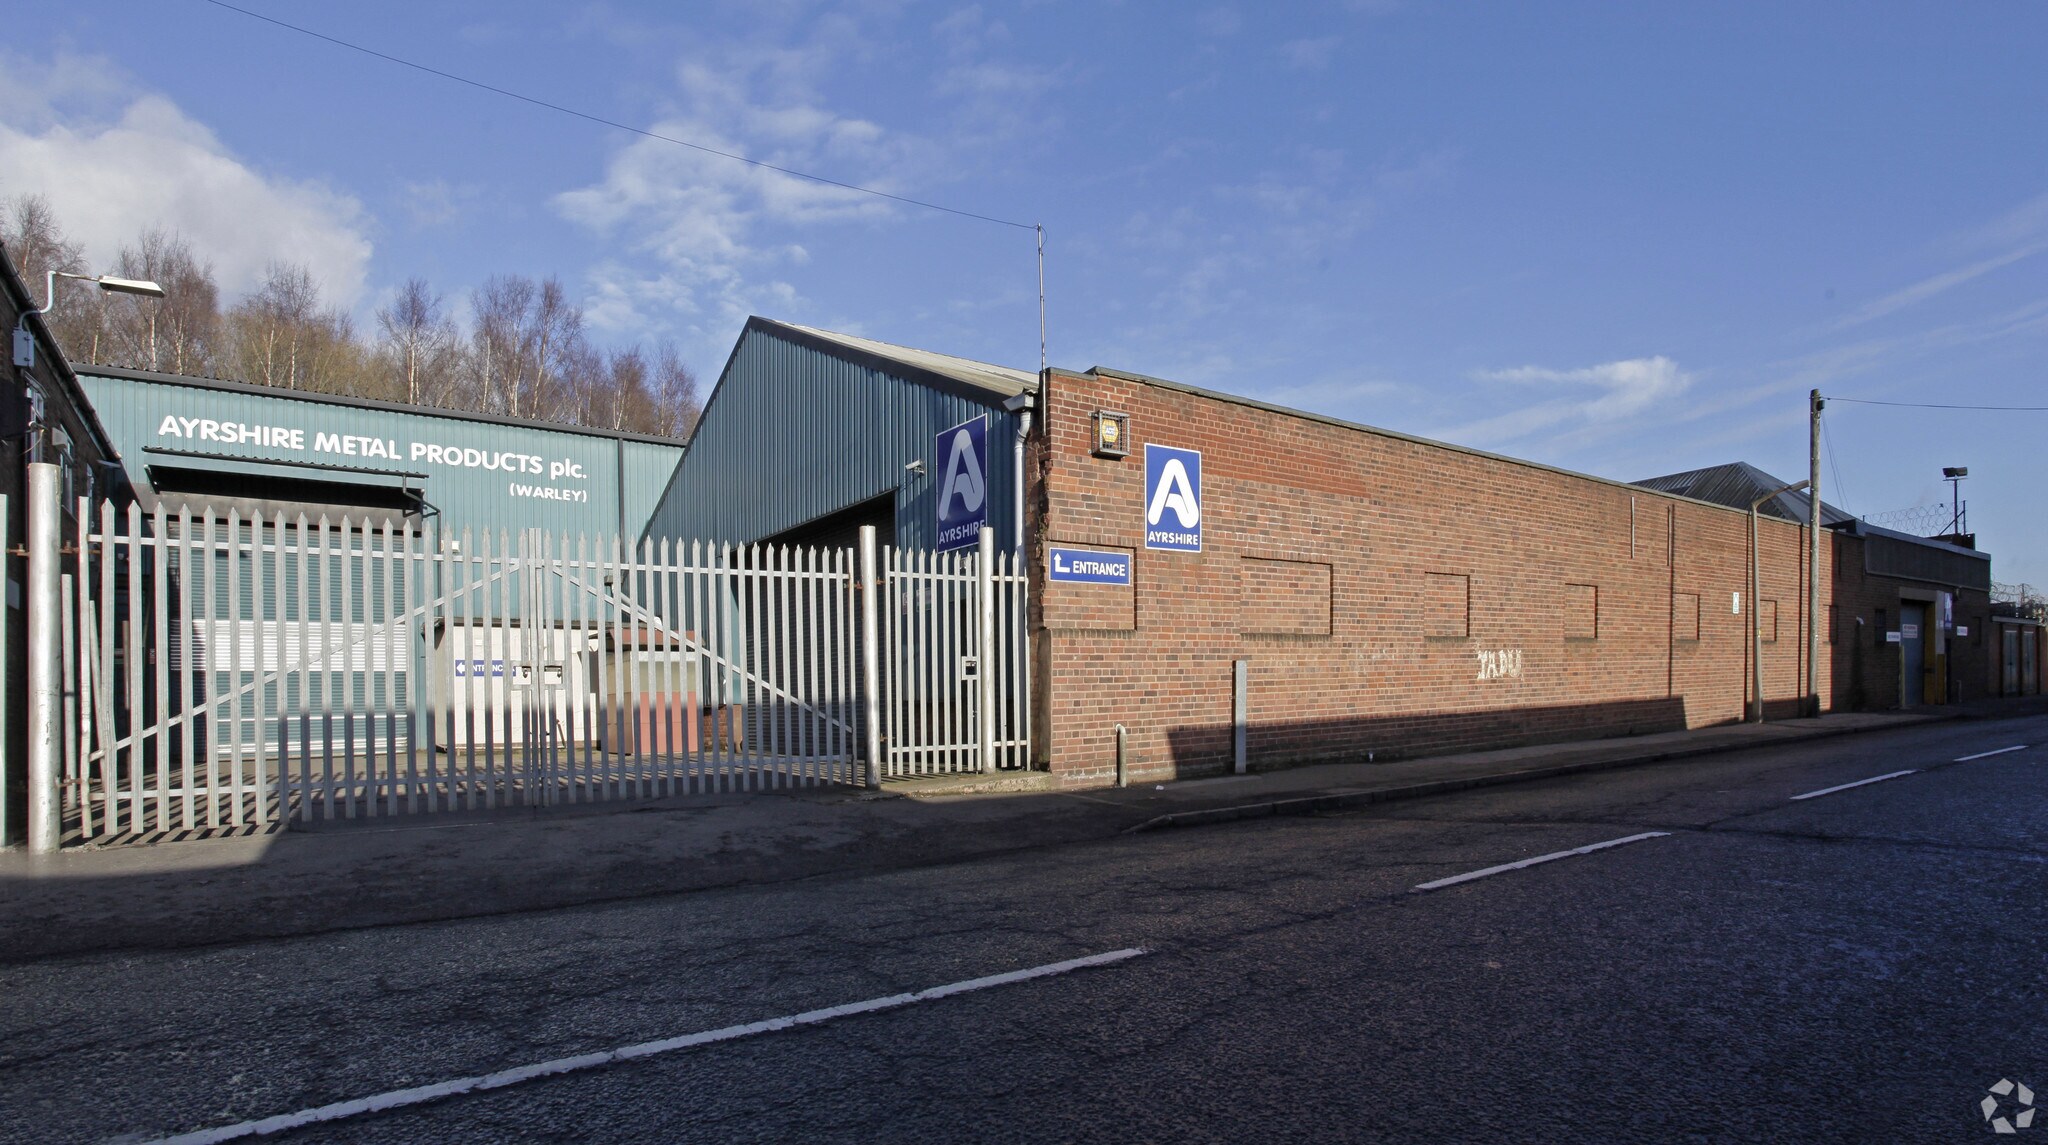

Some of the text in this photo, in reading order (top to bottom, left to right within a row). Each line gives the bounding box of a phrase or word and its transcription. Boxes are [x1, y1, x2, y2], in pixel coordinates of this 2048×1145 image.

[159, 415, 586, 481] AYRSHIRE METAL PRODUCTS plc.
[509, 482, 587, 503] (WARLEY)
[1148, 531, 1198, 546] AYRSHIRE
[1073, 560, 1126, 577] ENTRANCE
